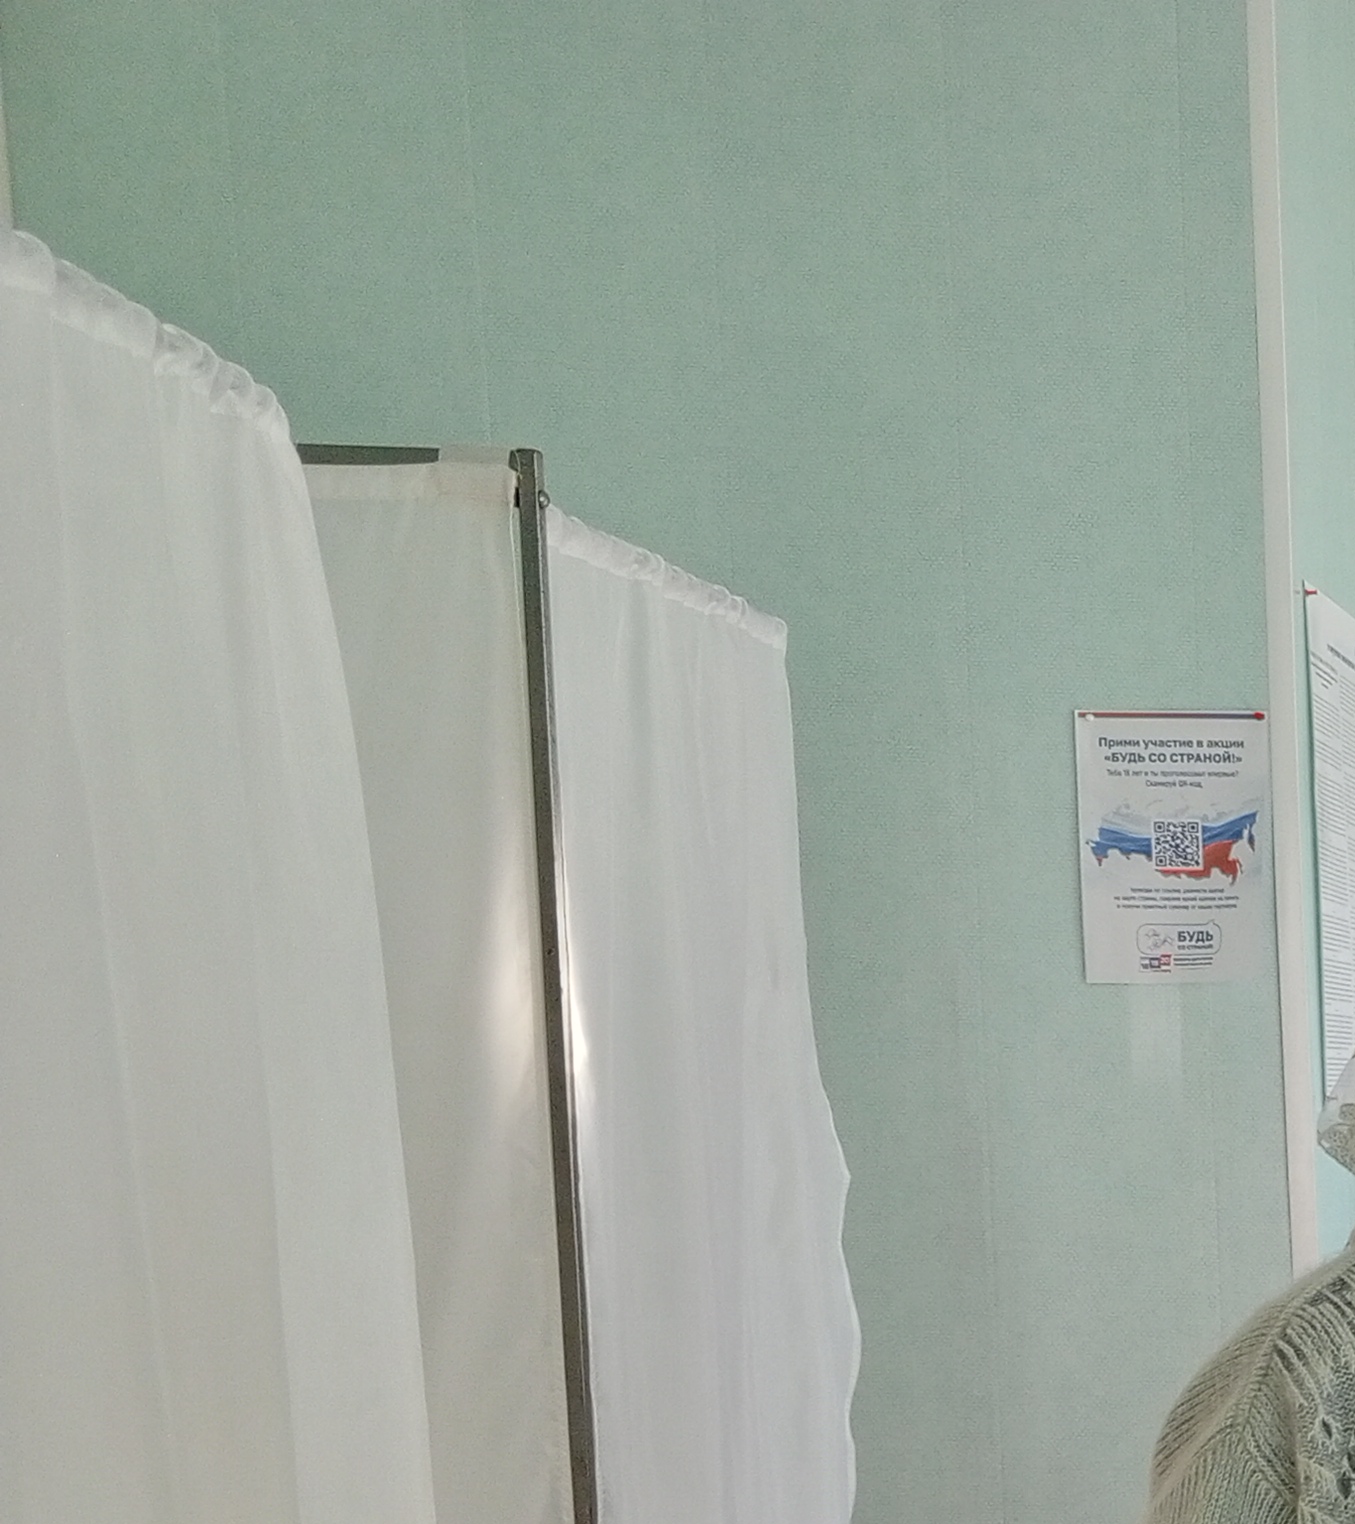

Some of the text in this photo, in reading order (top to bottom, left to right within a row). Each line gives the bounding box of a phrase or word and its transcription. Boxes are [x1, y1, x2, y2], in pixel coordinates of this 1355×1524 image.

[1098, 737, 1245, 749] Прими участие в акции
[1104, 751, 1242, 763] «БУДЬ СО СТРАНОЙ!»
[1177, 931, 1214, 943] БУДЬ
